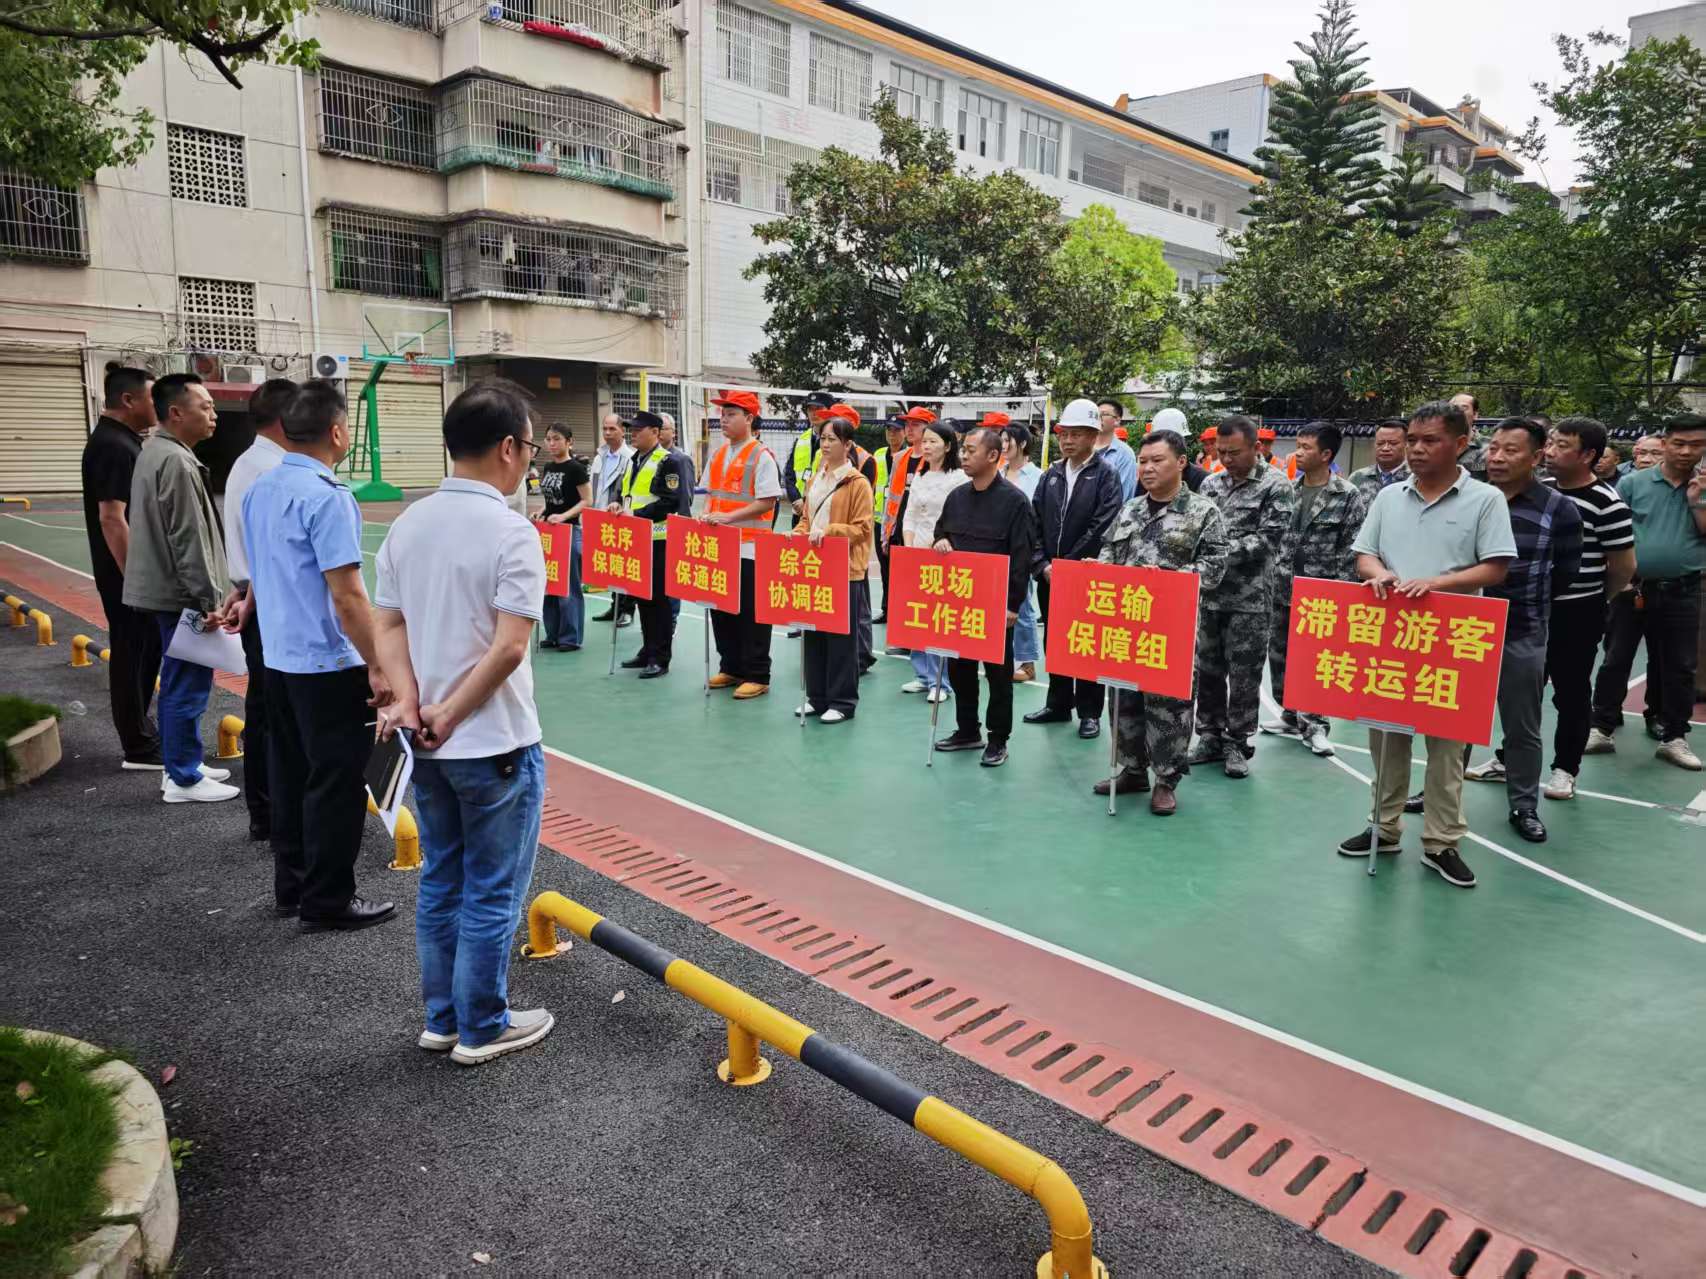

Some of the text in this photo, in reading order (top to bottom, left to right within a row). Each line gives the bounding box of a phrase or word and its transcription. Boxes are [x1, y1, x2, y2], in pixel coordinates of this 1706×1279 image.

[600, 523, 633, 551] 秩序
[685, 532, 719, 562] 抢通
[591, 549, 642, 582] 保障组
[675, 559, 729, 597] 保通组
[779, 548, 822, 579] 综合
[767, 583, 835, 615] 协调组
[919, 565, 975, 600] 现场
[1086, 580, 1154, 623] 运输
[904, 602, 988, 640] 工作组
[1296, 597, 1496, 662] 滞留游客
[1066, 621, 1169, 671] 保障组
[1315, 649, 1460, 711] 转运组
